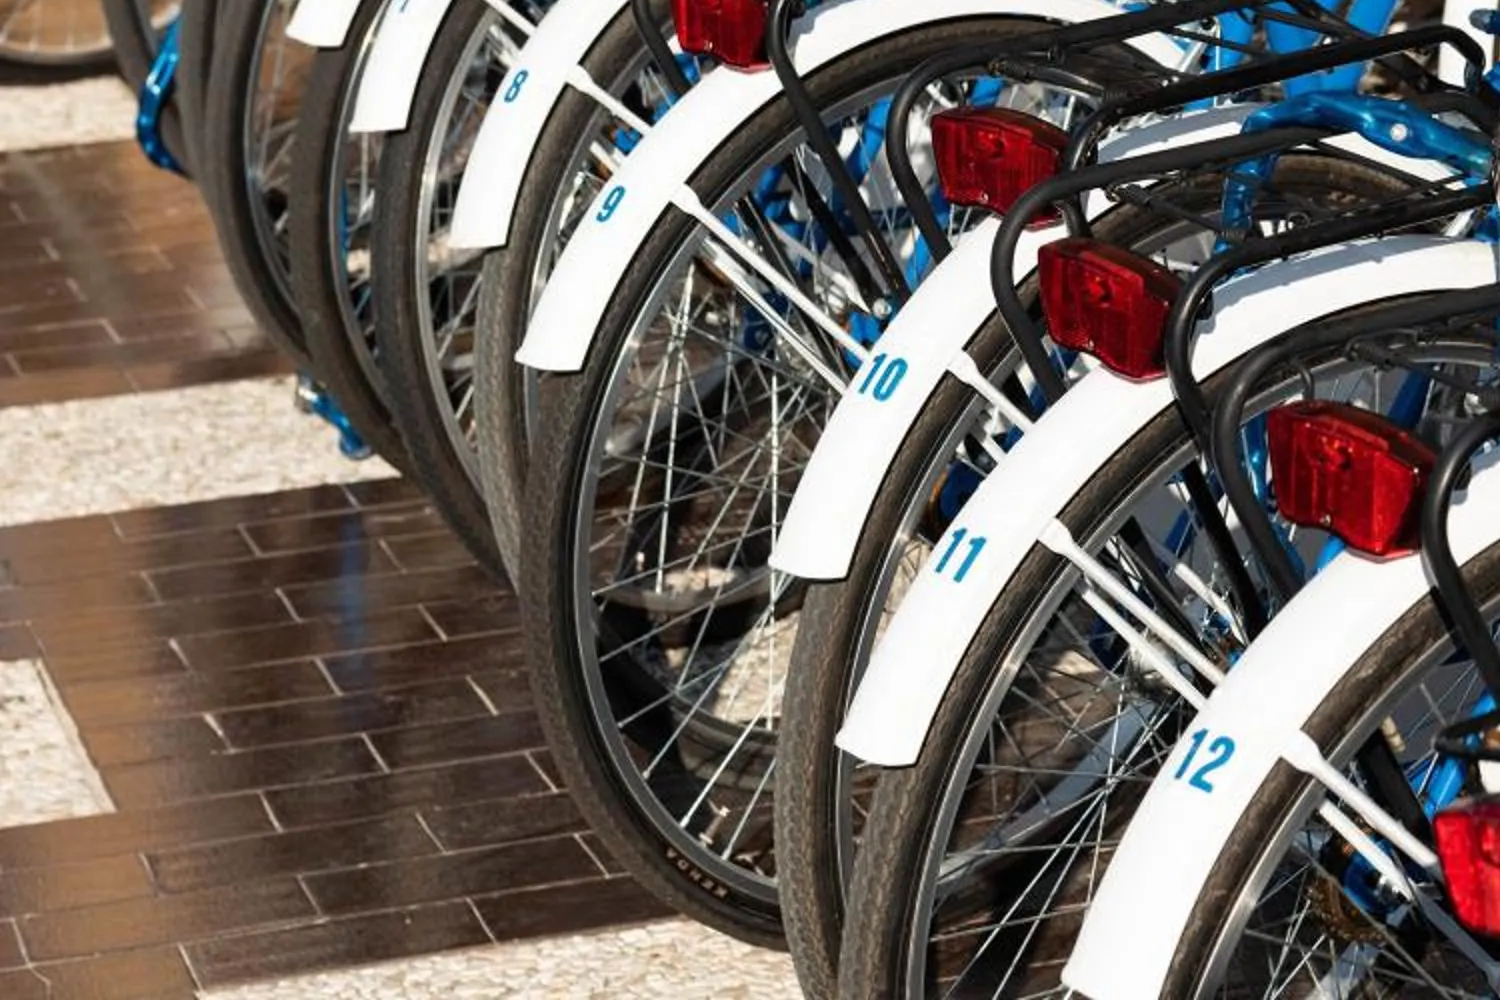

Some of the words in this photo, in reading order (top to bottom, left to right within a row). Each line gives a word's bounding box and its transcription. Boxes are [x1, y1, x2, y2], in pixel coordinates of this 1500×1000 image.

[503, 69, 529, 103] 8
[596, 185, 626, 223] 9
[858, 353, 909, 402] 10
[934, 528, 987, 583] 11
[1174, 728, 1235, 793] 12
